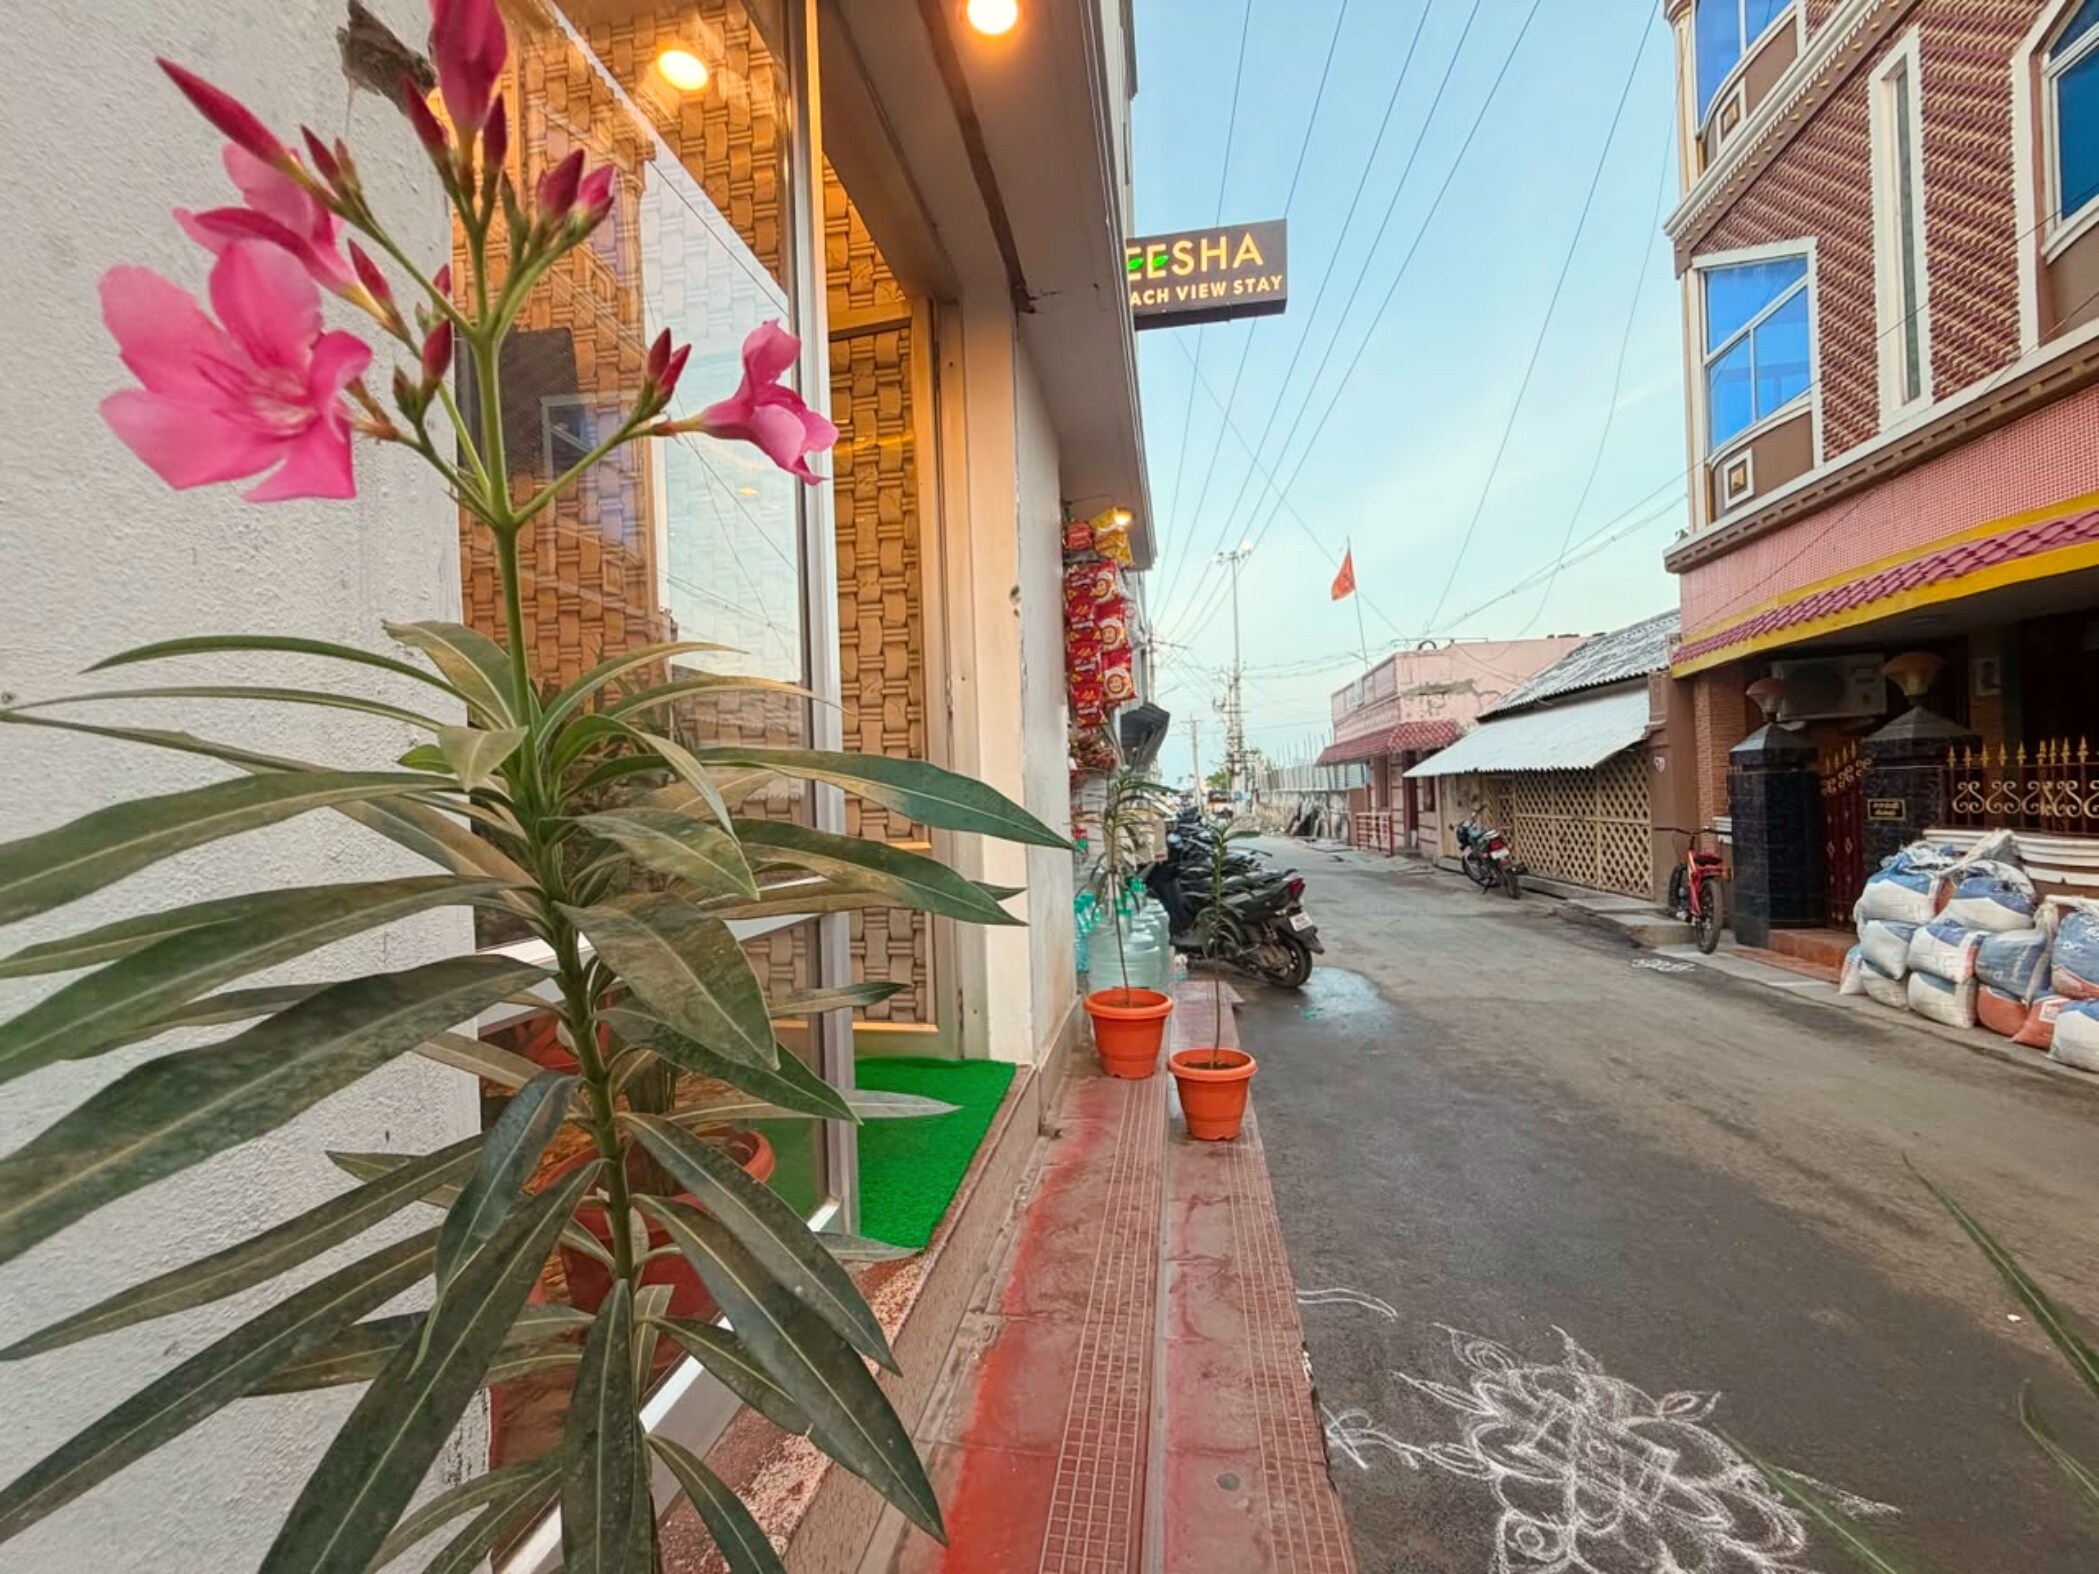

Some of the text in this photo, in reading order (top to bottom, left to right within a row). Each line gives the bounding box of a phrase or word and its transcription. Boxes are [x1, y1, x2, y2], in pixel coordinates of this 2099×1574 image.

[1126, 232, 1263, 281] EESHA
[1129, 275, 1283, 306] ACH VIEW STAY
